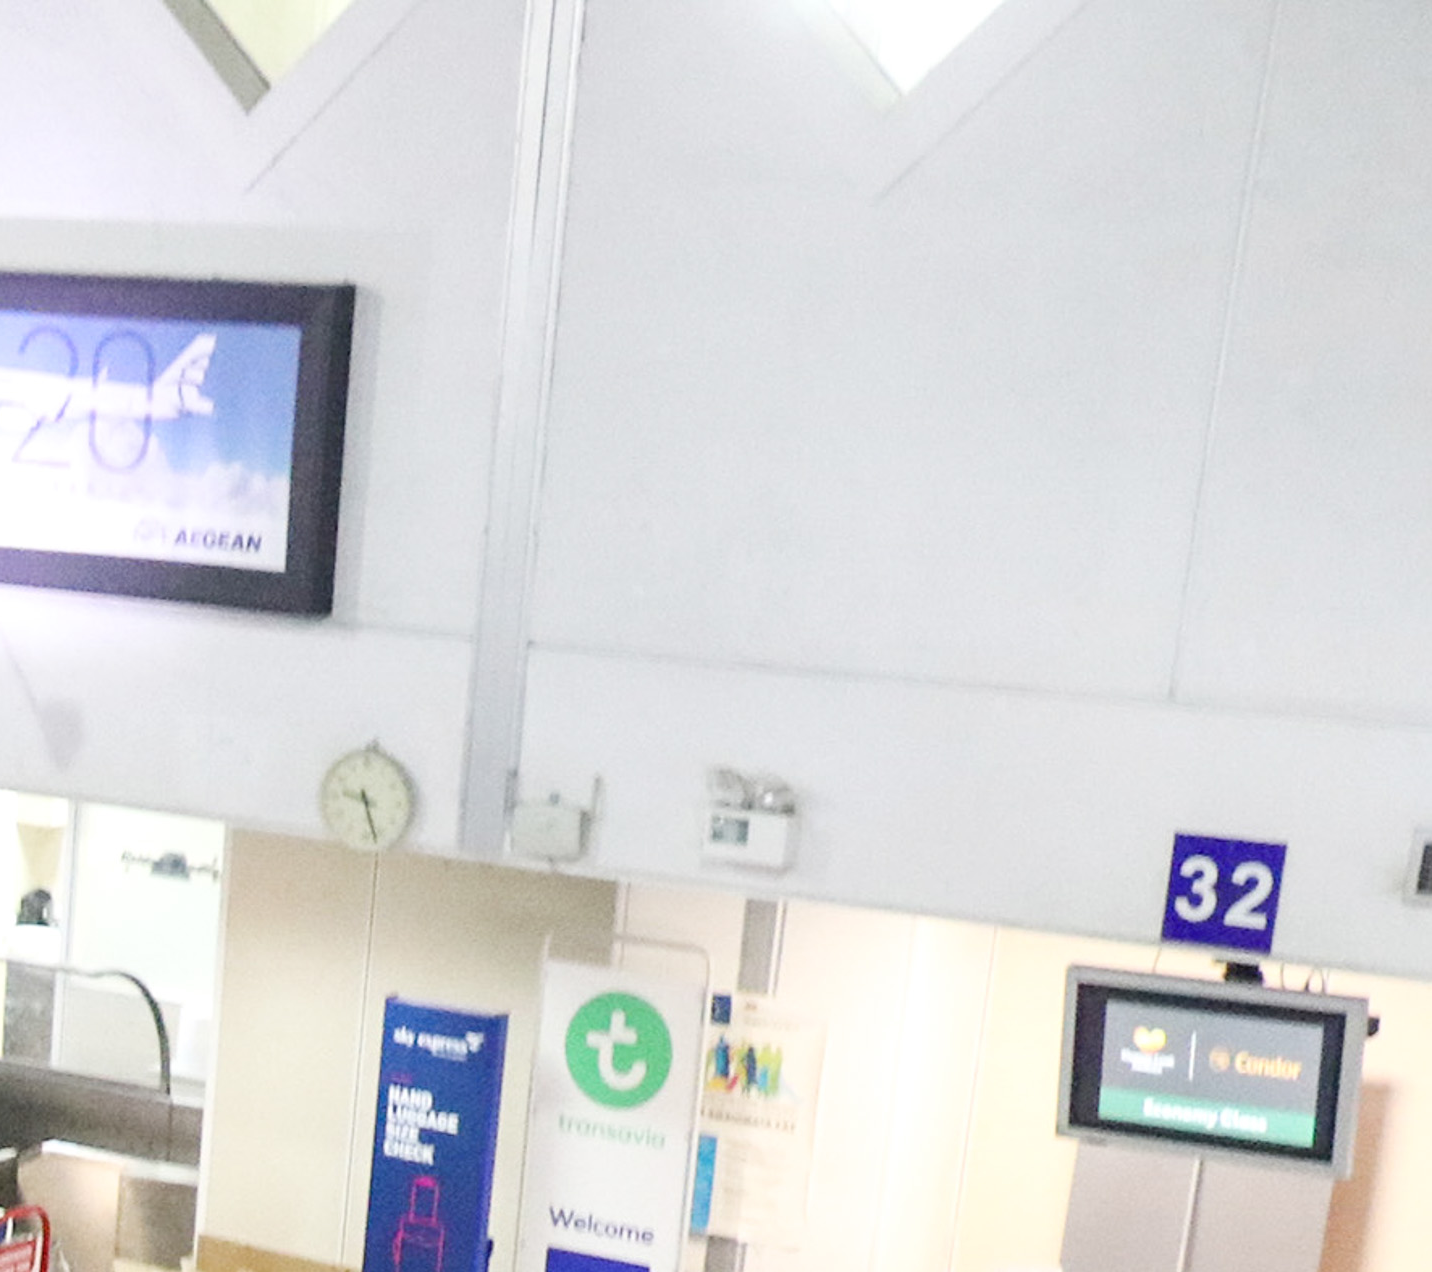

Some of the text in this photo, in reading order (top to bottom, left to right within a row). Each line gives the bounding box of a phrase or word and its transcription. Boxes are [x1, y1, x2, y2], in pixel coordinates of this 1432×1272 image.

[174, 529, 262, 553] AEGEAN
[1174, 855, 1275, 931] 32
[1234, 1051, 1302, 1081] Condor
[389, 1084, 433, 1111] HAND
[386, 1105, 459, 1135] LUGGAGE
[1143, 1098, 1267, 1134] Economy Class
[559, 1113, 666, 1150] transavia
[383, 1140, 435, 1166] CHECK
[549, 1205, 655, 1244] Welcome
